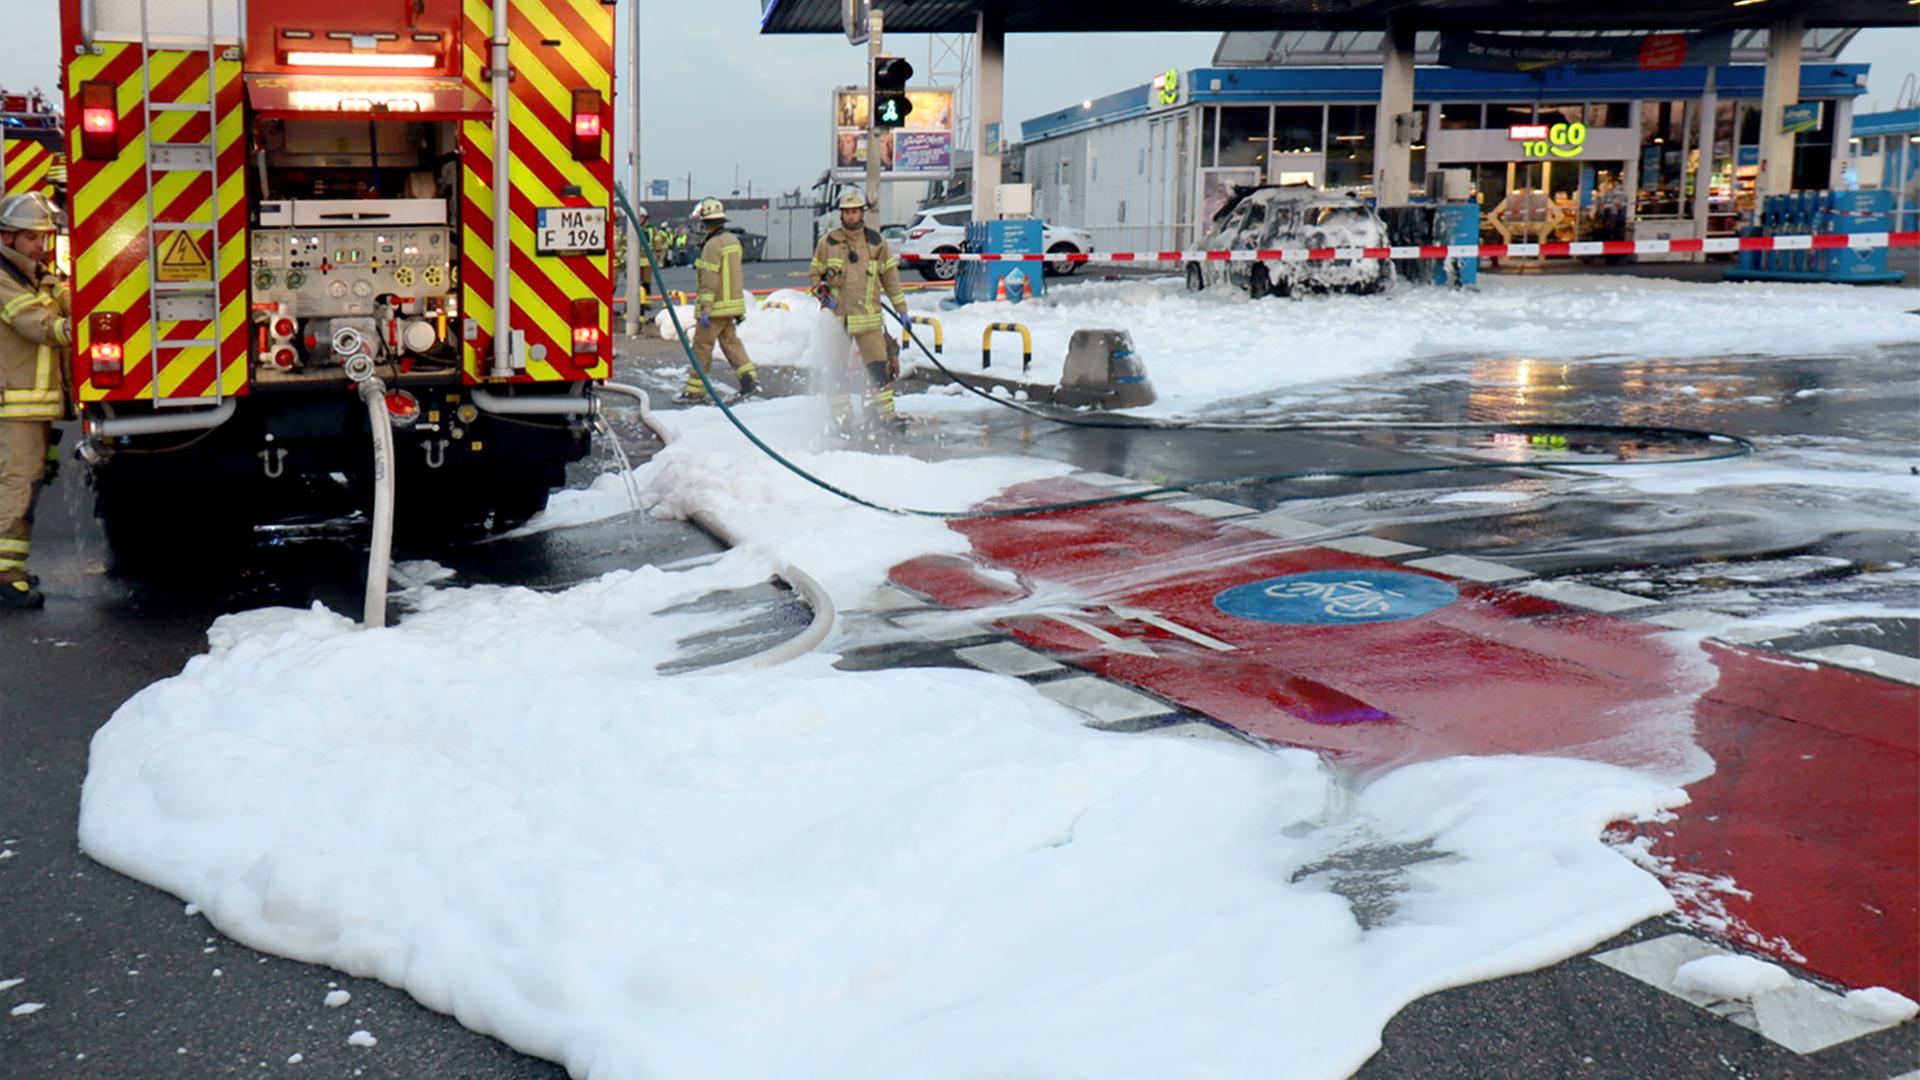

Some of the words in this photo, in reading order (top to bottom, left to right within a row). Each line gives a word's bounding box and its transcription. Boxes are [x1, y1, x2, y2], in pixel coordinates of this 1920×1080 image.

[1549, 122, 1587, 146] GO
[1522, 141, 1548, 157] TO
[561, 211, 584, 228] MA
[545, 230, 556, 247] F
[567, 229, 599, 247] 196
